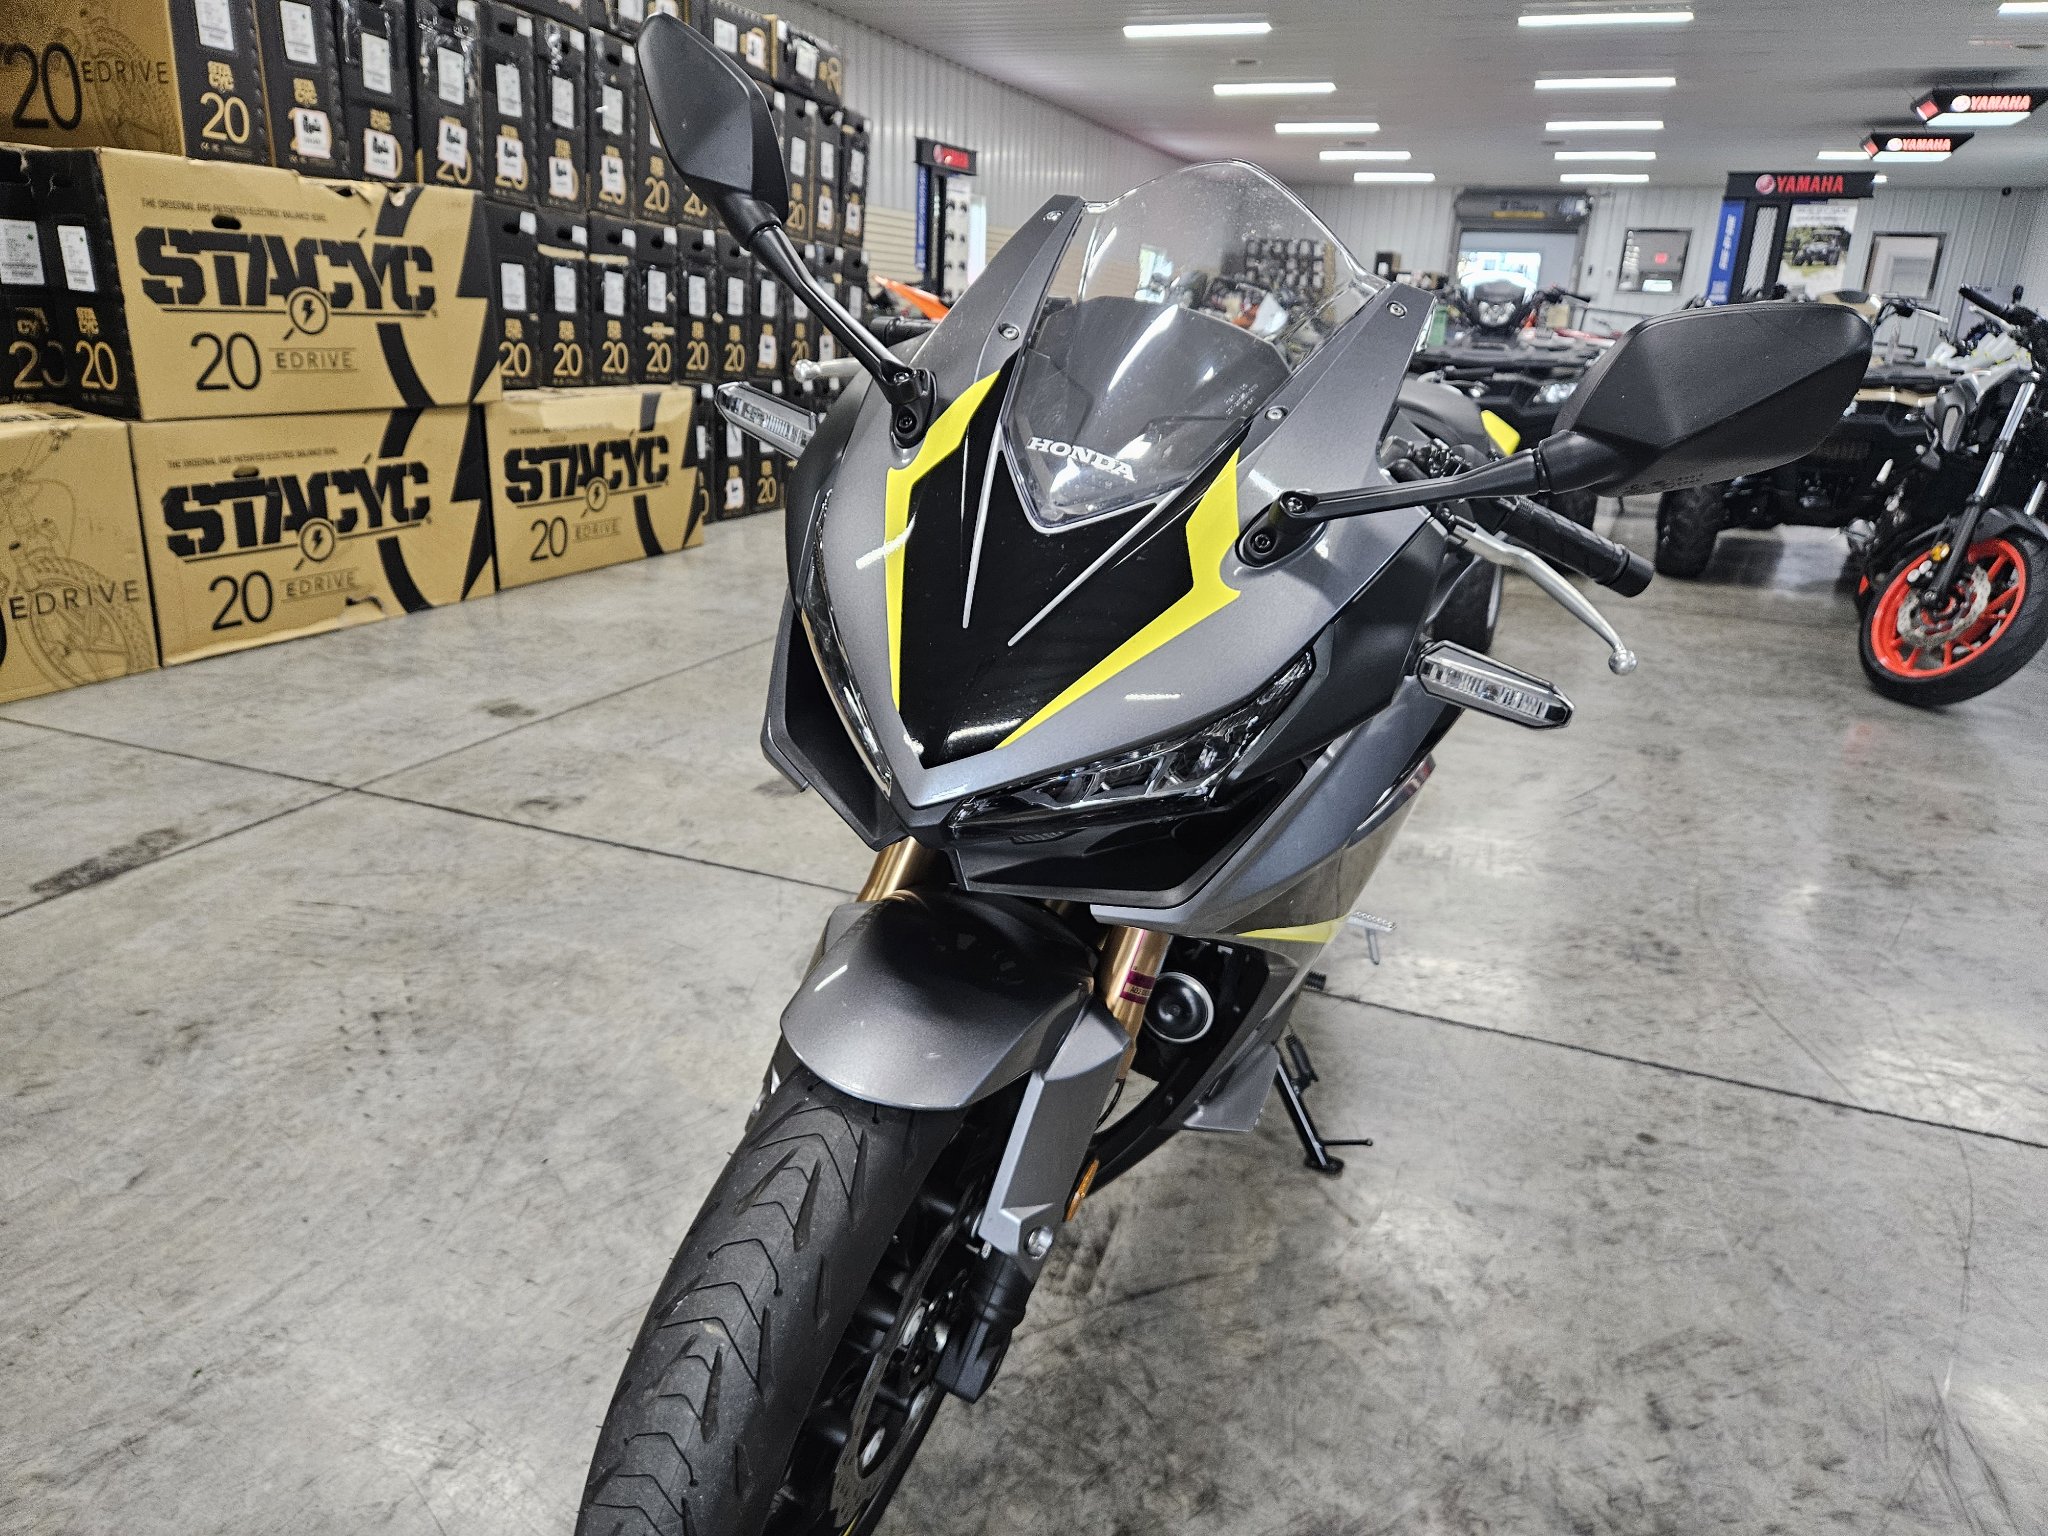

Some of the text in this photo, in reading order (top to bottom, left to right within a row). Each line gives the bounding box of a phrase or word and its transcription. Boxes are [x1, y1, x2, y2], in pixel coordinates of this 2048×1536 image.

[2, 42, 169, 131] 20 EDRIVE
[1970, 95, 2031, 112] YAMAHA
[200, 92, 250, 144] 20
[1902, 138, 1952, 152] YAMAHA
[644, 177, 670, 213] 20
[1776, 175, 1844, 193] YAMAHA
[135, 226, 436, 311] STACYC
[76, 340, 118, 391] 20
[190, 332, 352, 391] 20 EDRIVE
[499, 341, 532, 377] 20
[553, 342, 583, 377] 20
[602, 341, 629, 374] 20
[646, 341, 672, 373] 20
[686, 340, 710, 371] 20
[724, 343, 746, 372] 20
[504, 435, 669, 504] STACYC
[1025, 437, 1138, 483] HONDA
[161, 461, 430, 557] STACYC
[757, 476, 777, 504] 20
[530, 516, 568, 562] 20
[9, 580, 140, 620] EDRIVE
[208, 570, 355, 631] 20 EDRIVE
